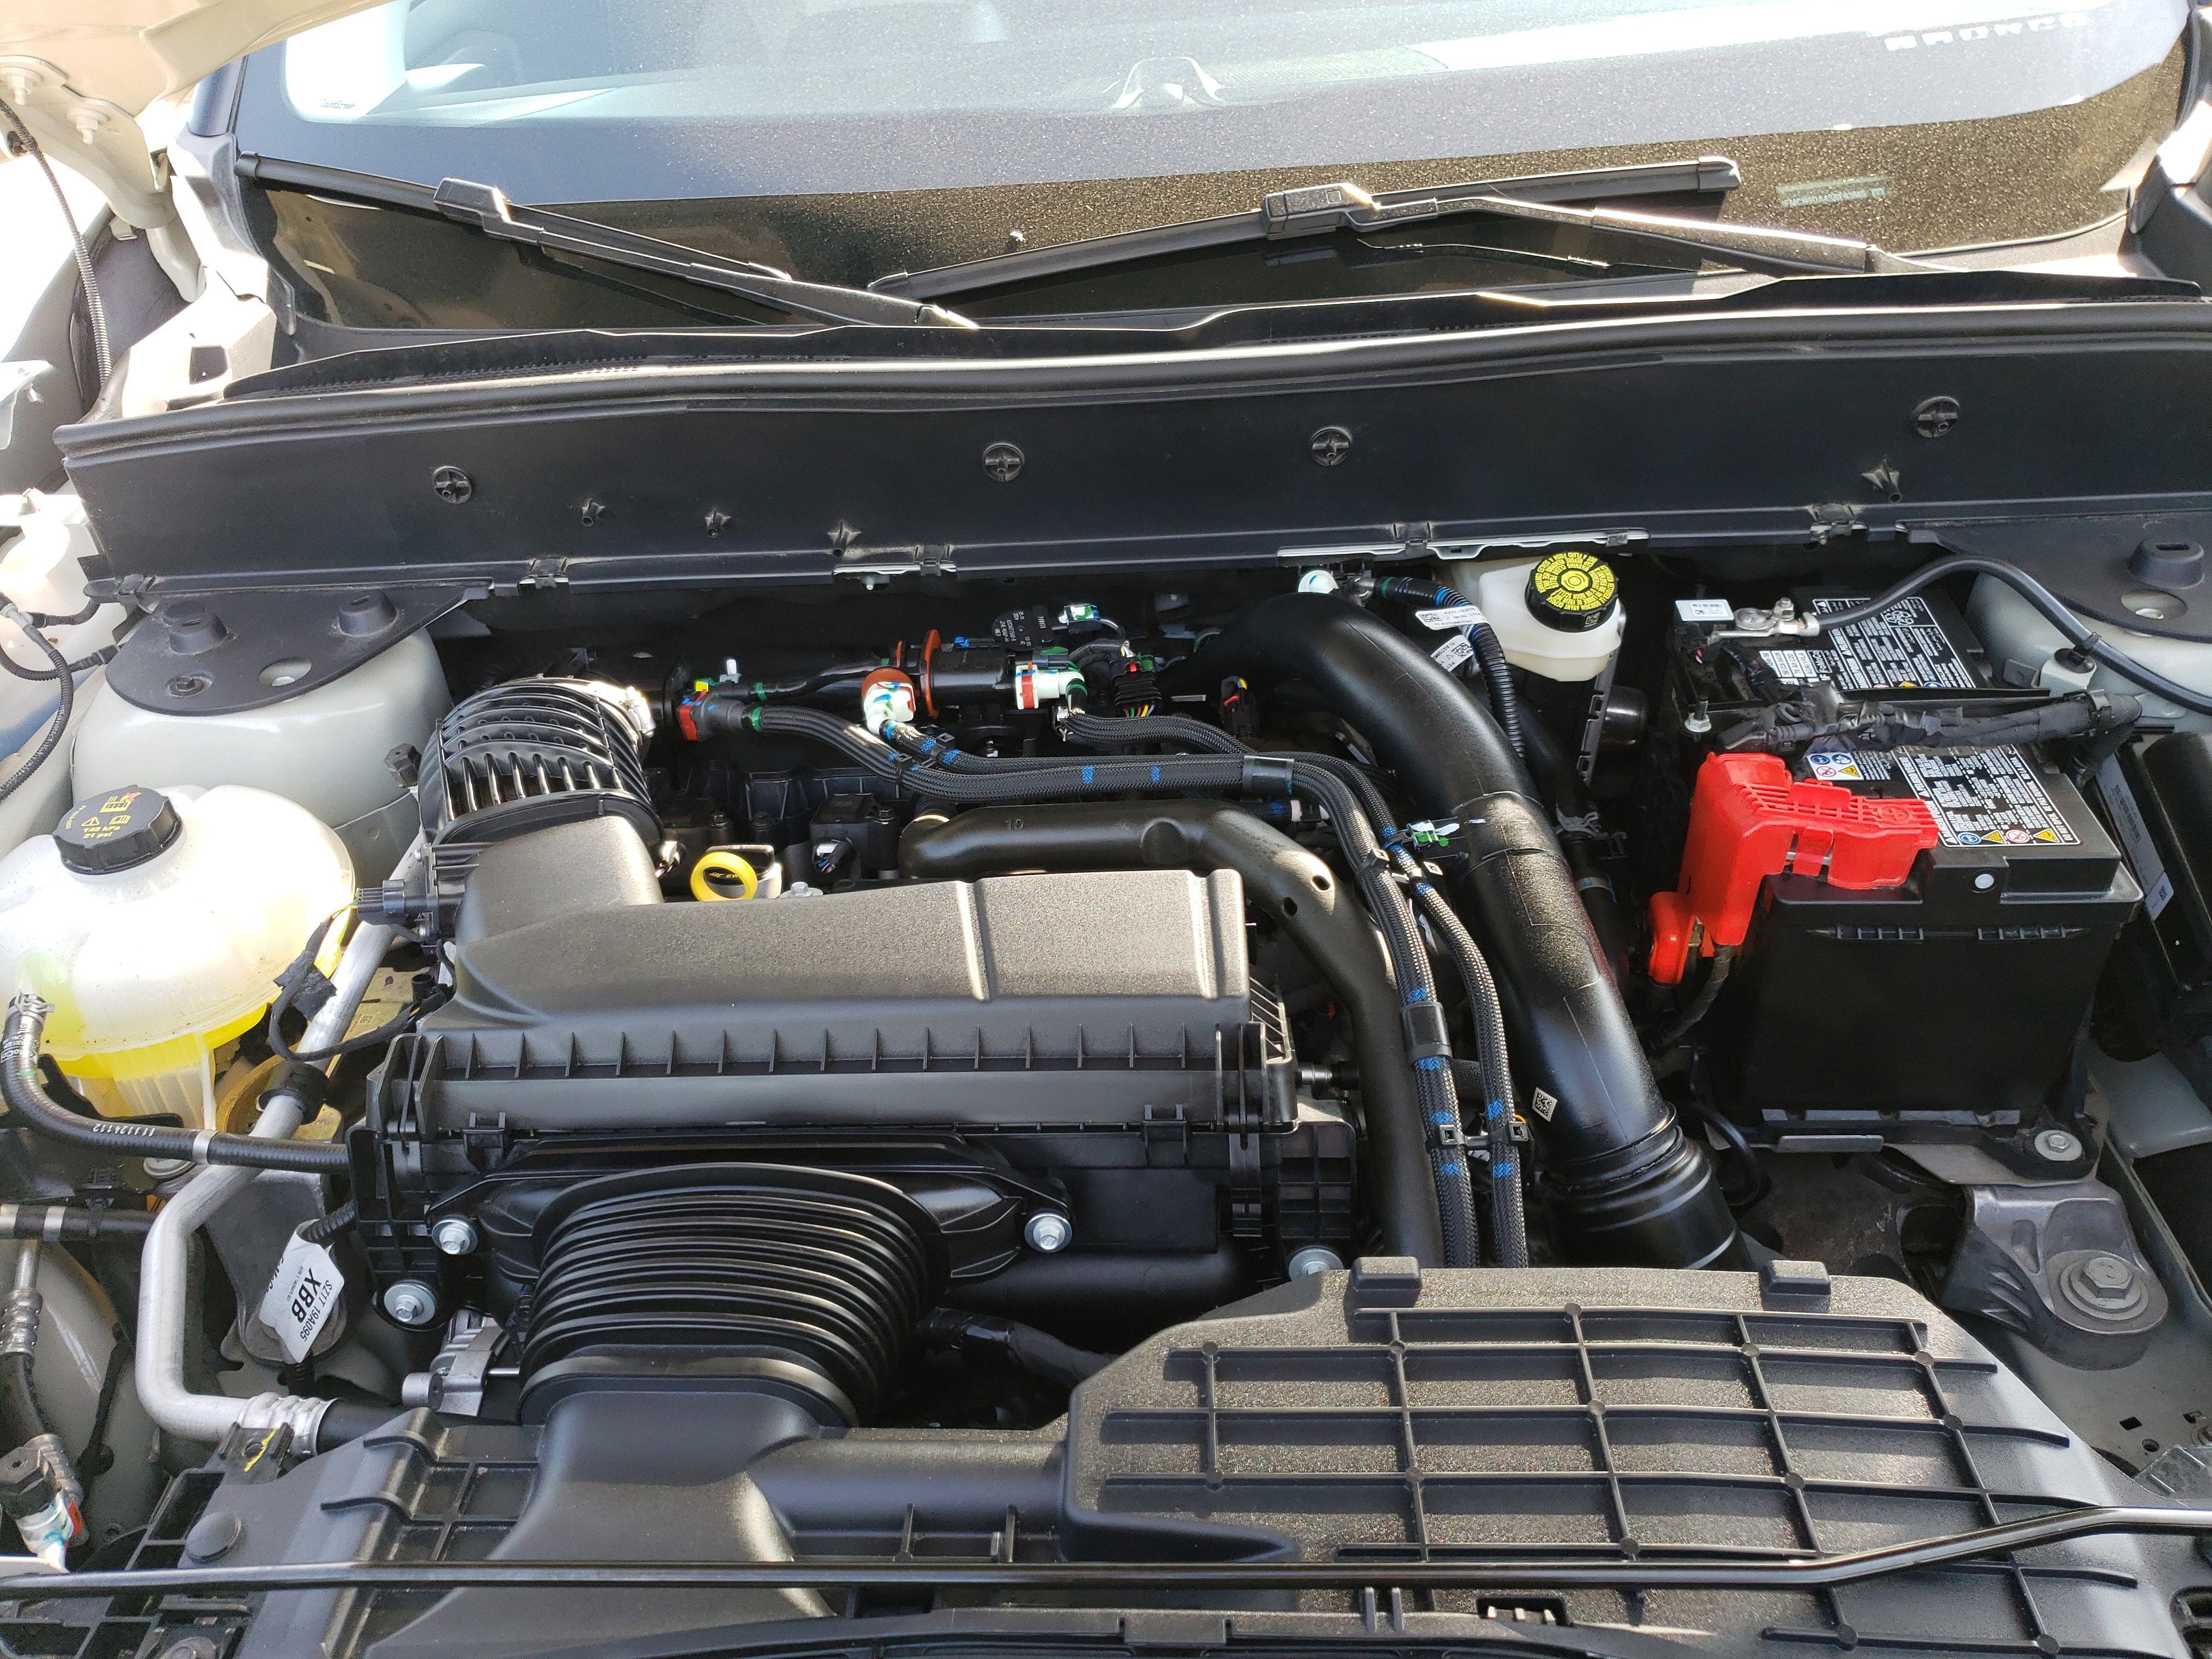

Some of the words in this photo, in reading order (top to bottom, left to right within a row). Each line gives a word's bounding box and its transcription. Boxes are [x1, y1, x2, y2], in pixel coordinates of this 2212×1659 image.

[1812, 651, 1829, 673] FoMoCo
[291, 1267, 322, 1323] XBB
[318, 1279, 332, 1307] SZ1T
[300, 1305, 321, 1342] 19A095
